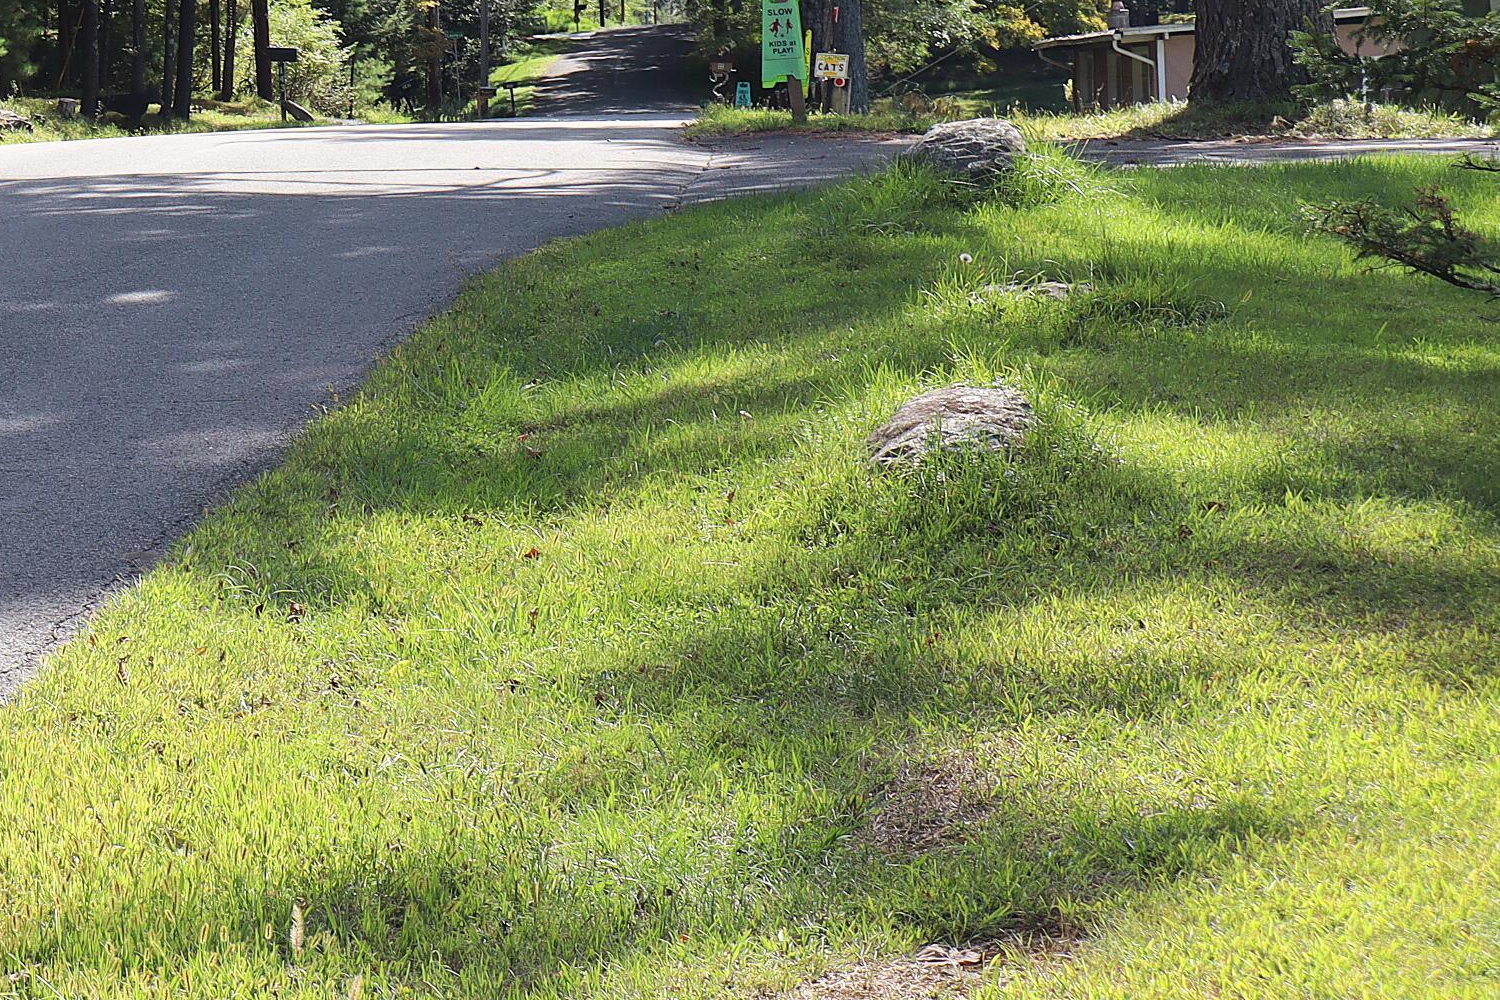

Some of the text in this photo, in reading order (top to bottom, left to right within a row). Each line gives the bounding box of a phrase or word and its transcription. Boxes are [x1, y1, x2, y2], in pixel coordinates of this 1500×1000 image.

[767, 7, 793, 16] SLOW
[768, 40, 787, 48] KIDS
[818, 62, 844, 72] CATS
